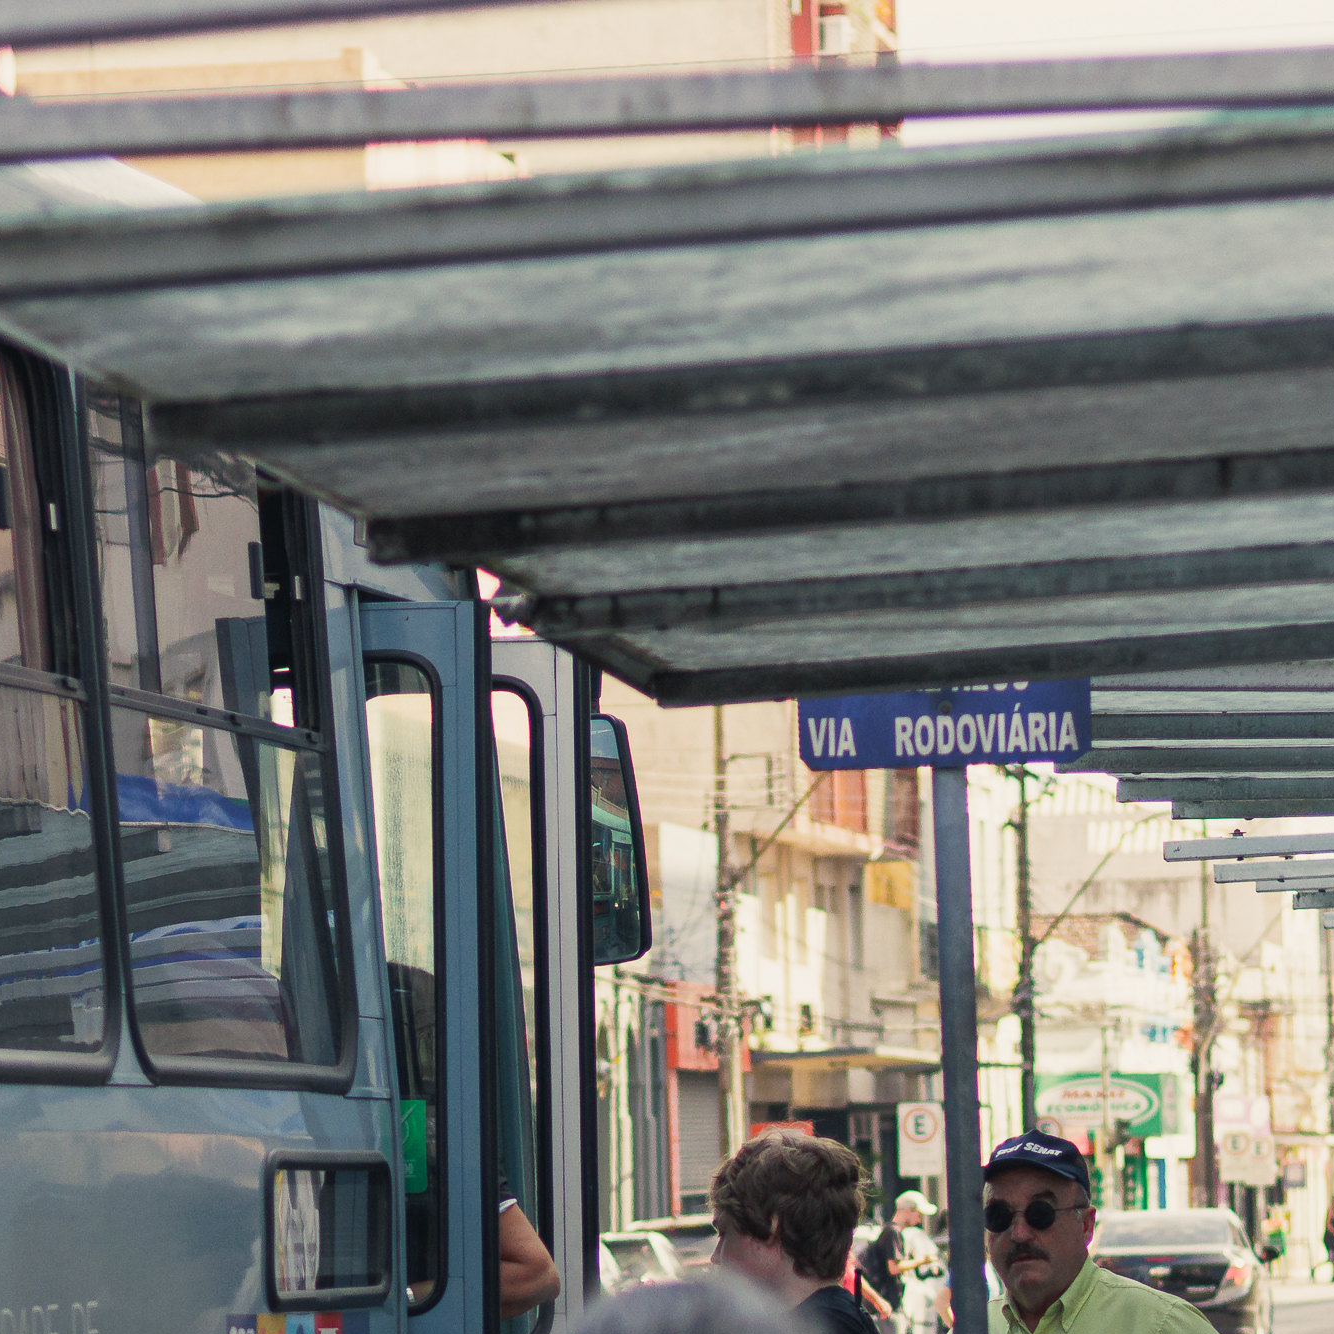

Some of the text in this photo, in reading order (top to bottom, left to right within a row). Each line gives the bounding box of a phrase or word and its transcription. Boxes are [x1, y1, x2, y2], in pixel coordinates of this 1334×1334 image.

[808, 702, 1080, 758] VIA RODOVIÁRIA
[914, 1115, 926, 1135] E
[1024, 1142, 1063, 1156] SENAT
